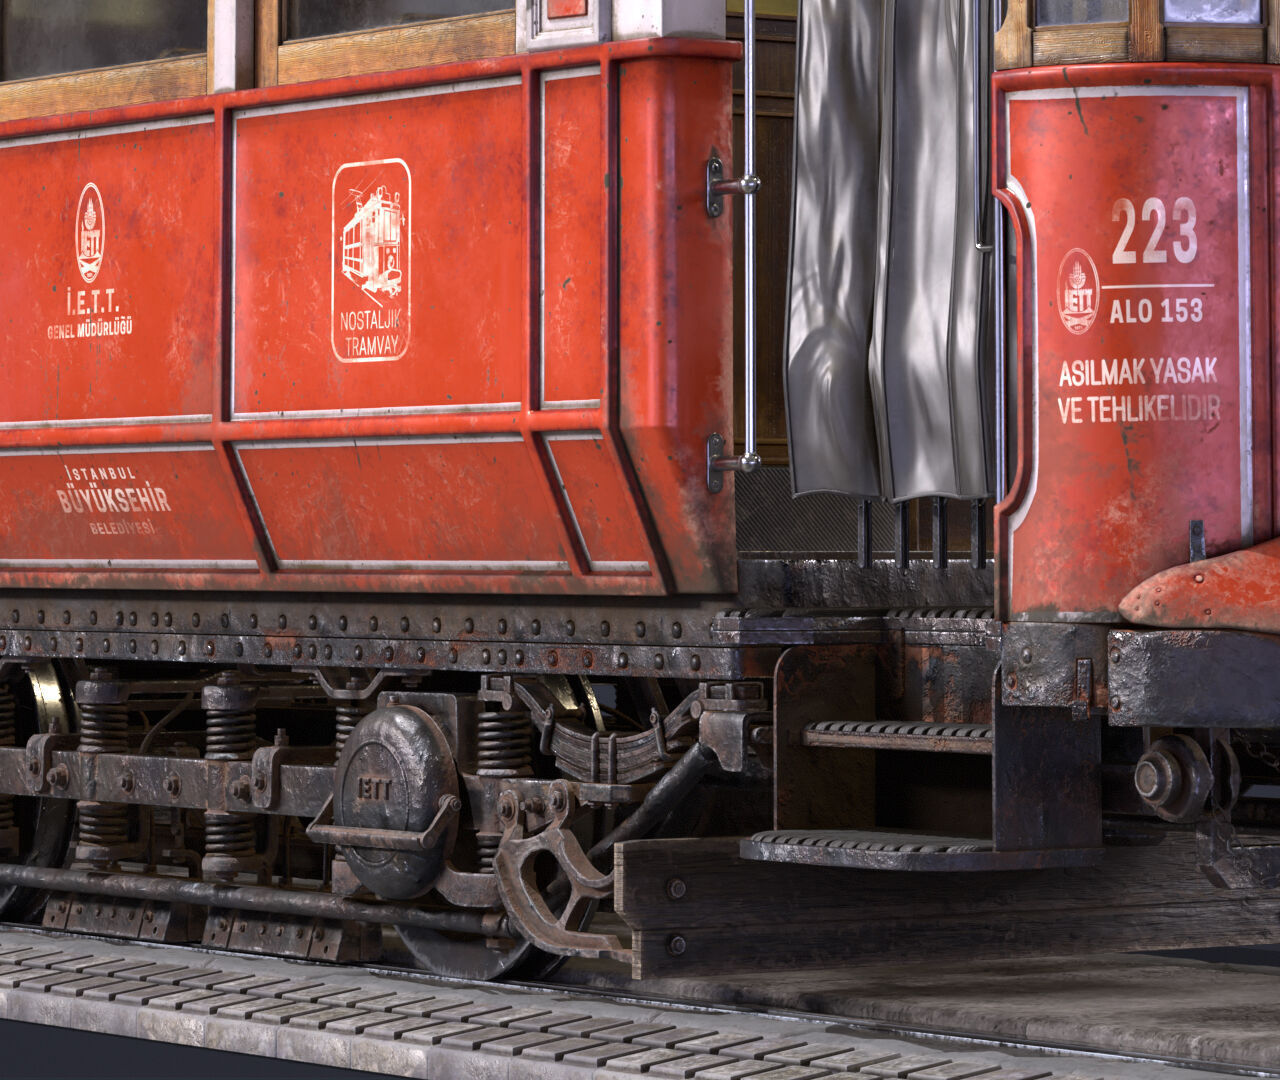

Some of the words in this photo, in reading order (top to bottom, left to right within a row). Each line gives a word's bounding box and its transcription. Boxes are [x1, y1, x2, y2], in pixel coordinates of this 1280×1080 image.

[1111, 196, 1198, 265] 223
[1109, 298, 1153, 324] ALO
[1161, 297, 1204, 323] 153
[47, 324, 75, 340] GENEL
[76, 316, 133, 338] MÜDÜRLÜĞÜ
[345, 334, 399, 357] TRAMVAY
[1058, 357, 1146, 387] ASILMAK
[1150, 356, 1218, 385] YASAK
[1057, 396, 1083, 424] VE
[1086, 394, 1221, 423] TEHLIKELIDIR
[64, 464, 136, 481] İSTANBUL
[89, 518, 156, 535] BELEDİYESİ
